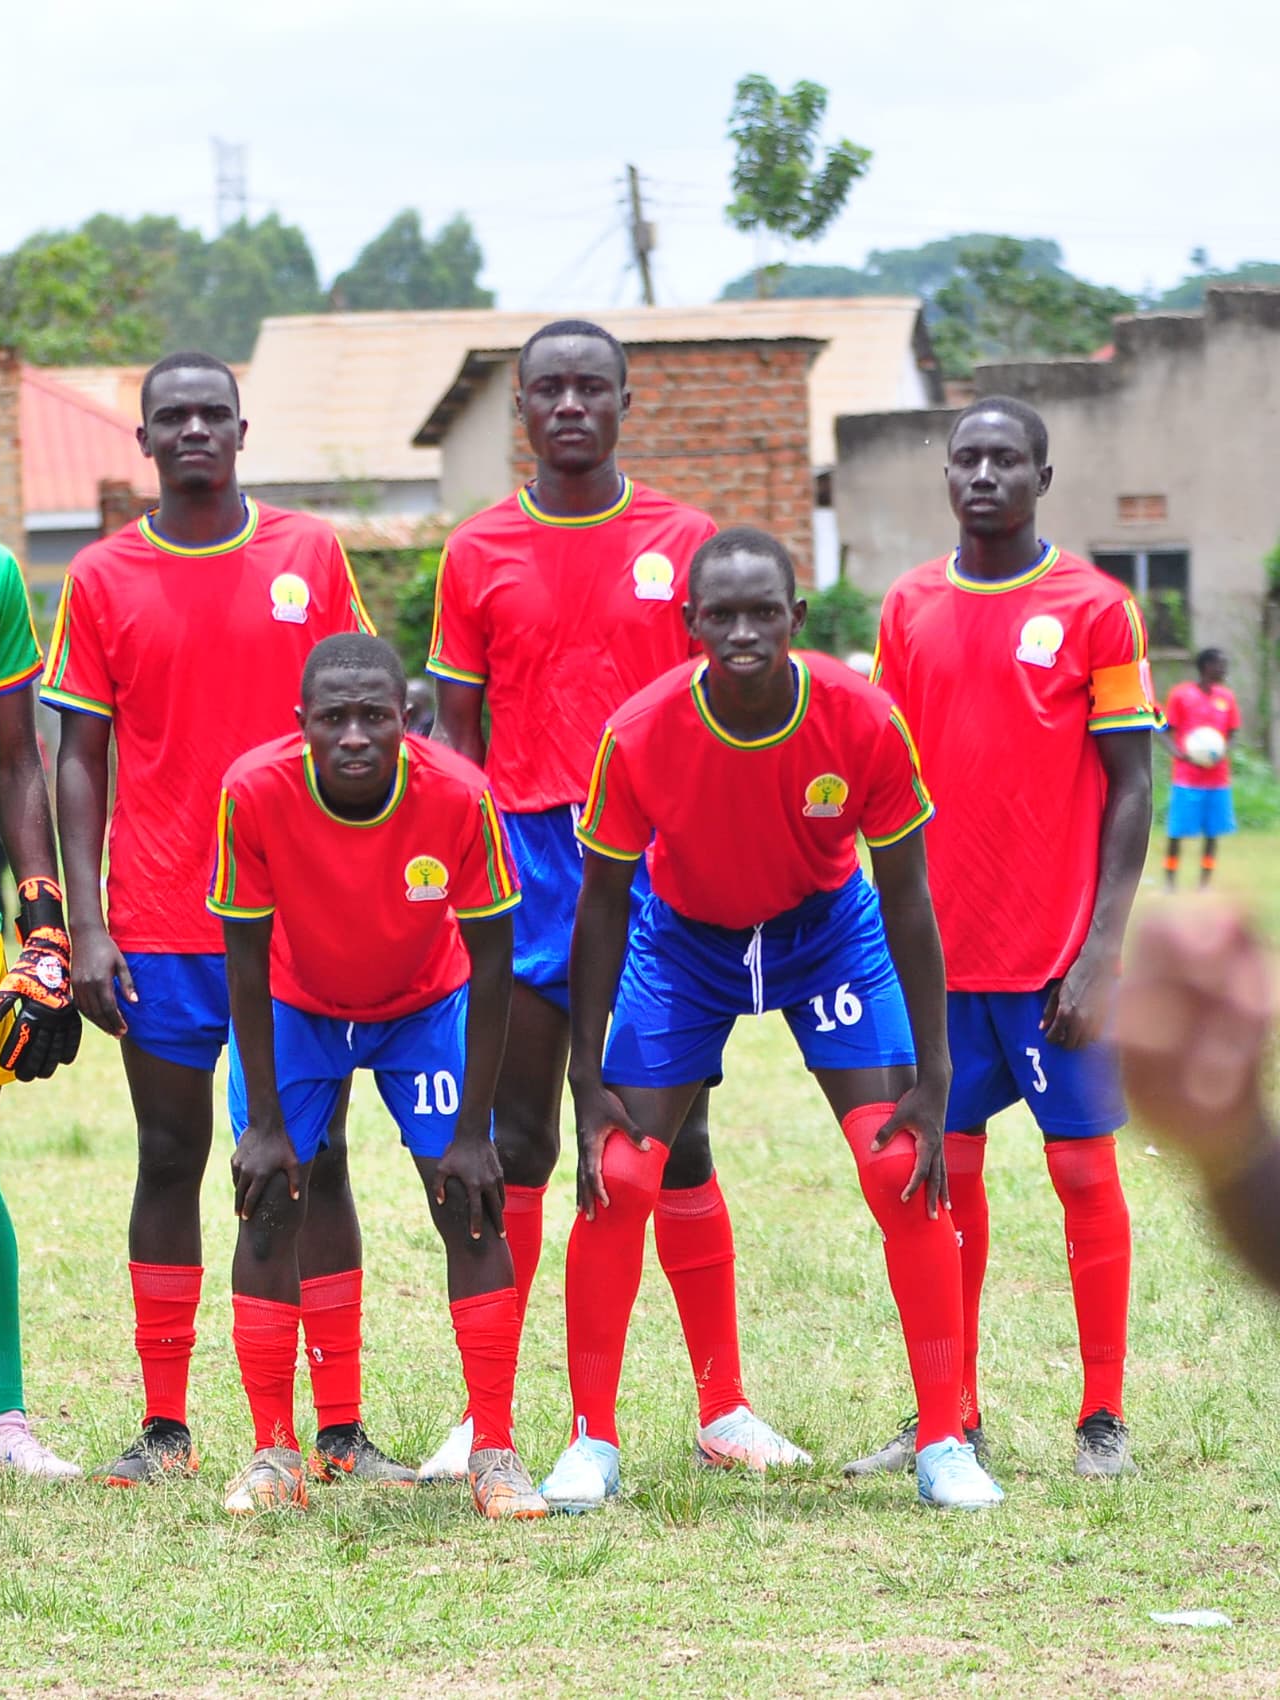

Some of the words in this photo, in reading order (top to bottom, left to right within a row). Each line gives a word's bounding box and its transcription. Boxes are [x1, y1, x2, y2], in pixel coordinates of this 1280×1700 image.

[809, 982, 863, 1032] 16
[414, 1070, 459, 1115] 10
[1026, 1047, 1048, 1093] 3
